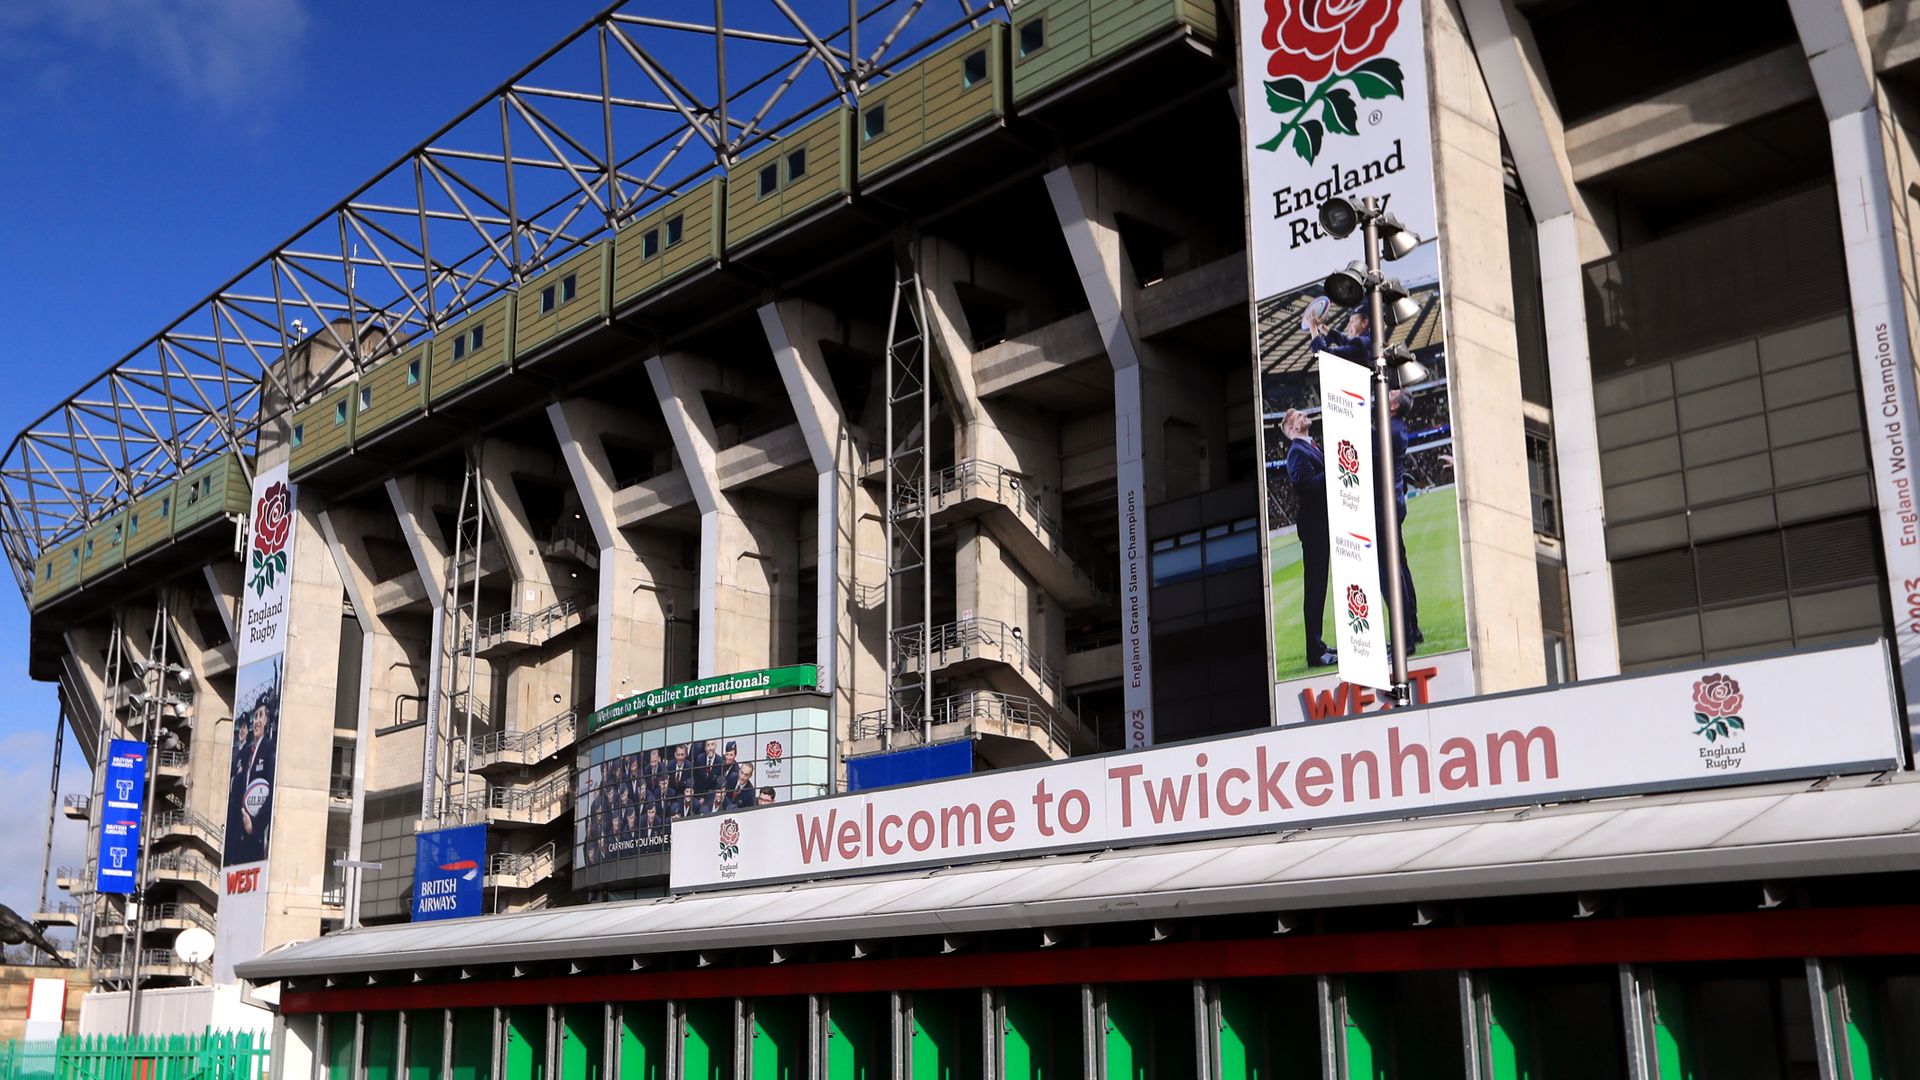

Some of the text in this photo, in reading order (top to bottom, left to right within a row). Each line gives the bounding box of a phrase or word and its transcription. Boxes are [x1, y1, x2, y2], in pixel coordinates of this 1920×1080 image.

[1272, 138, 1406, 220] England
[1875, 323, 1898, 418] Champions
[1327, 392, 1353, 409] BRITISH
[1327, 402, 1354, 419] AIRWAYS
[1885, 422, 1906, 475] World
[1127, 490, 1138, 560] Champions
[1895, 478, 1919, 547] England
[1335, 536, 1361, 552] BRITISH
[1335, 546, 1362, 562] AIRWAYS
[1129, 563, 1138, 593] Slam
[247, 595, 283, 626] England
[1130, 596, 1139, 634] Grand
[250, 620, 278, 643] Rugby
[1131, 639, 1142, 689] England
[633, 696, 647, 711] the
[646, 689, 682, 707] Quilter
[683, 672, 770, 698] Internationals
[1699, 742, 1746, 759] England
[1705, 756, 1742, 769] Rugby
[796, 726, 1559, 865] Welcome to Twickenham
[608, 840, 634, 853] CARRYING
[635, 837, 648, 847] YOU
[648, 834, 669, 846] HOME
[719, 863, 739, 872] England
[721, 870, 737, 879] Rugby
[227, 867, 262, 896] WEST
[421, 878, 457, 897] BRITISH
[418, 895, 457, 913] AIRWAYS
